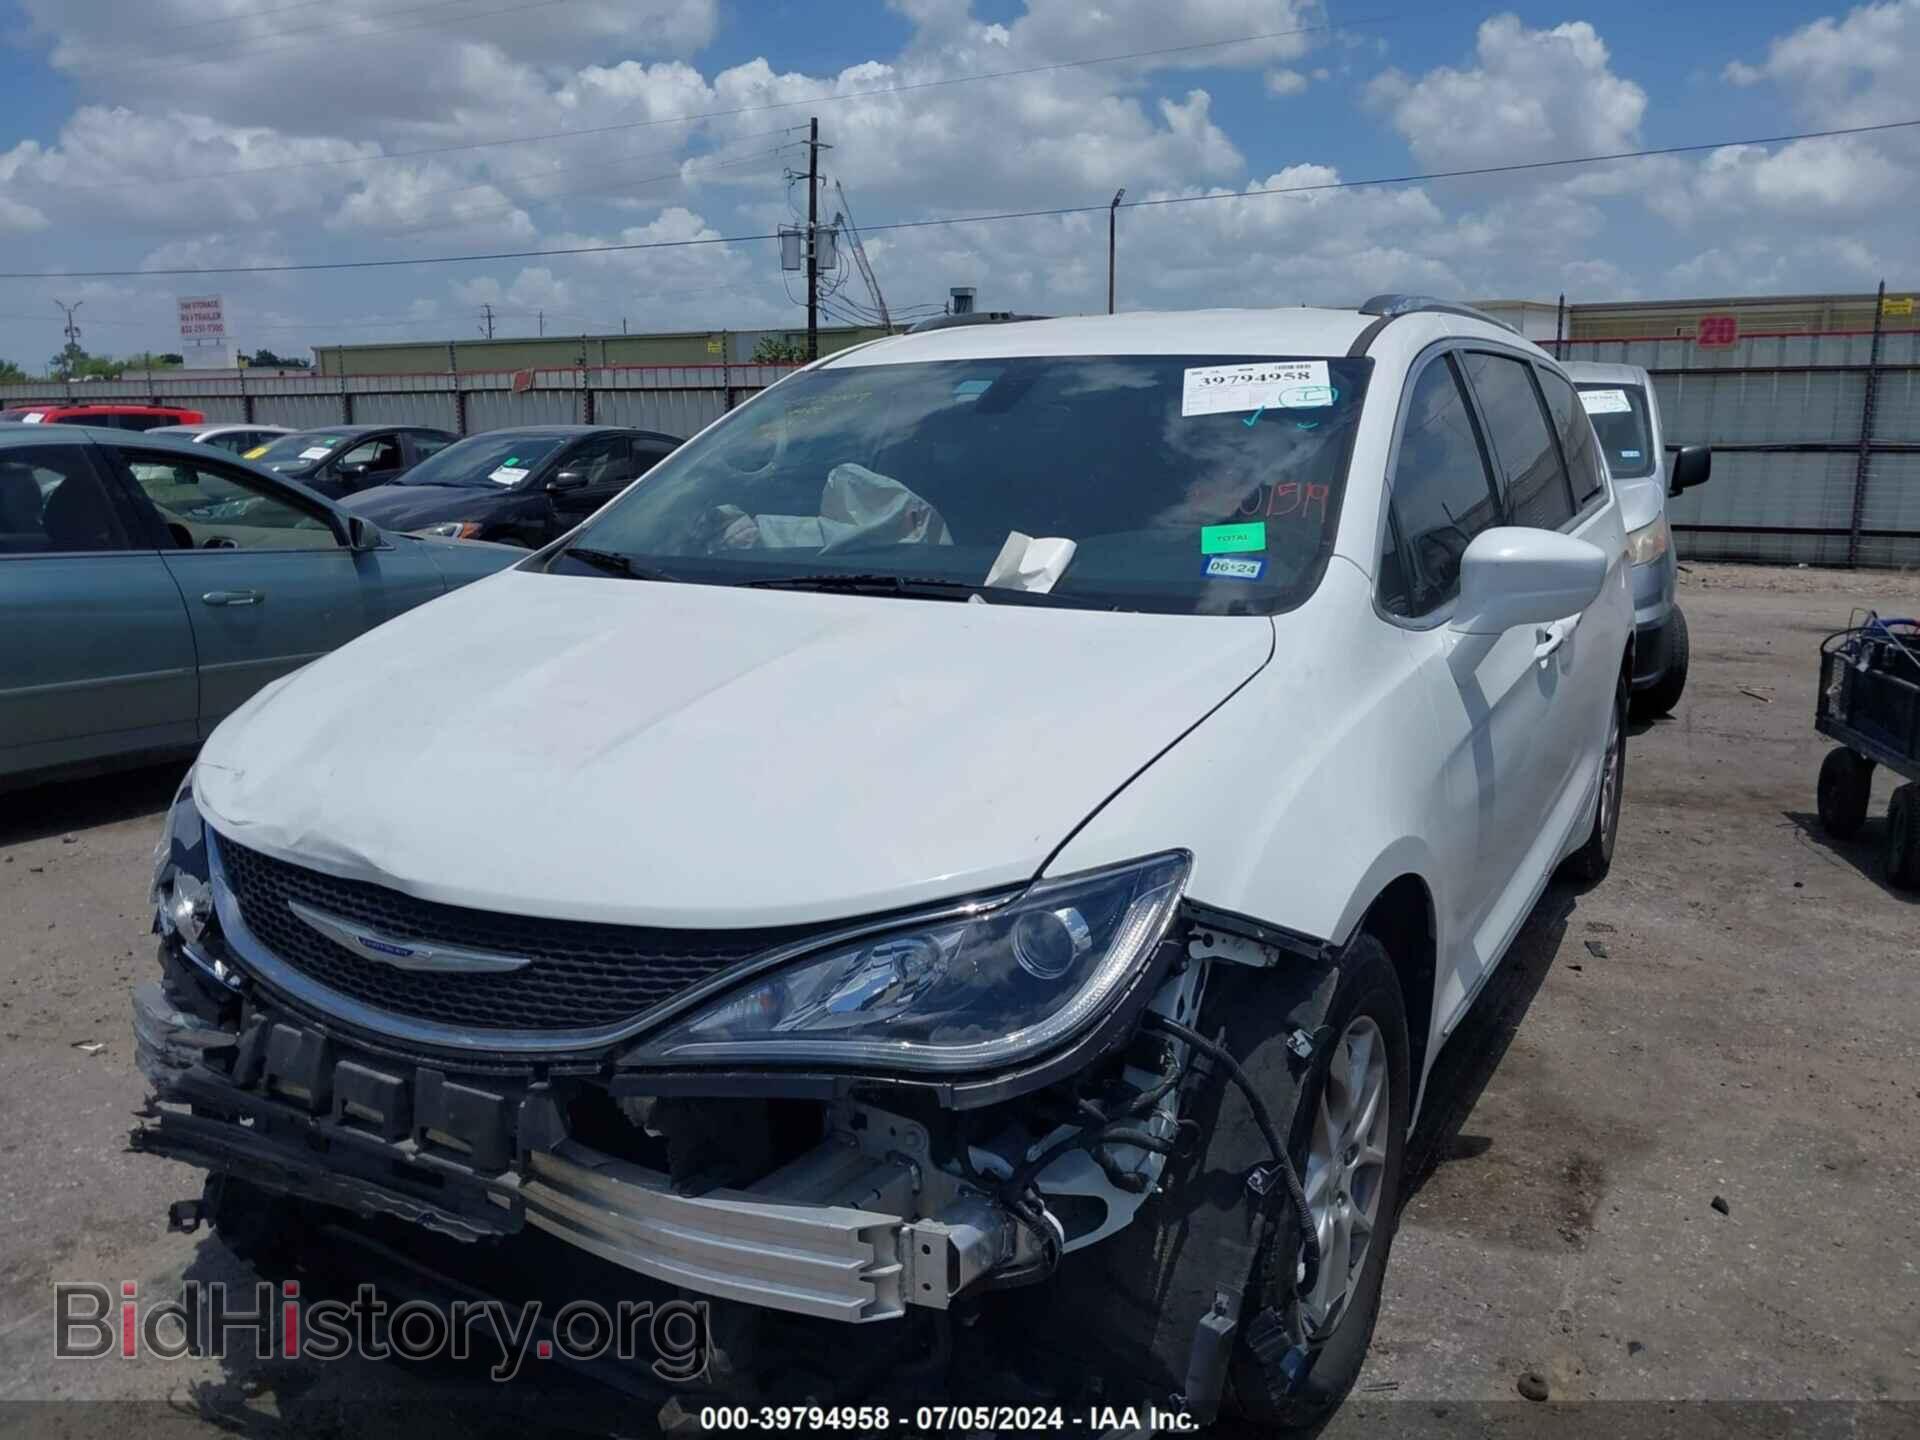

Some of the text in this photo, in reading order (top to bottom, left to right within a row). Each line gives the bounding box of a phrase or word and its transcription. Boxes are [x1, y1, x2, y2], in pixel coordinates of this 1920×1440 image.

[1700, 319, 1735, 344] 20
[1199, 371, 1311, 386] 39794958
[1216, 534, 1249, 542] TOTAL
